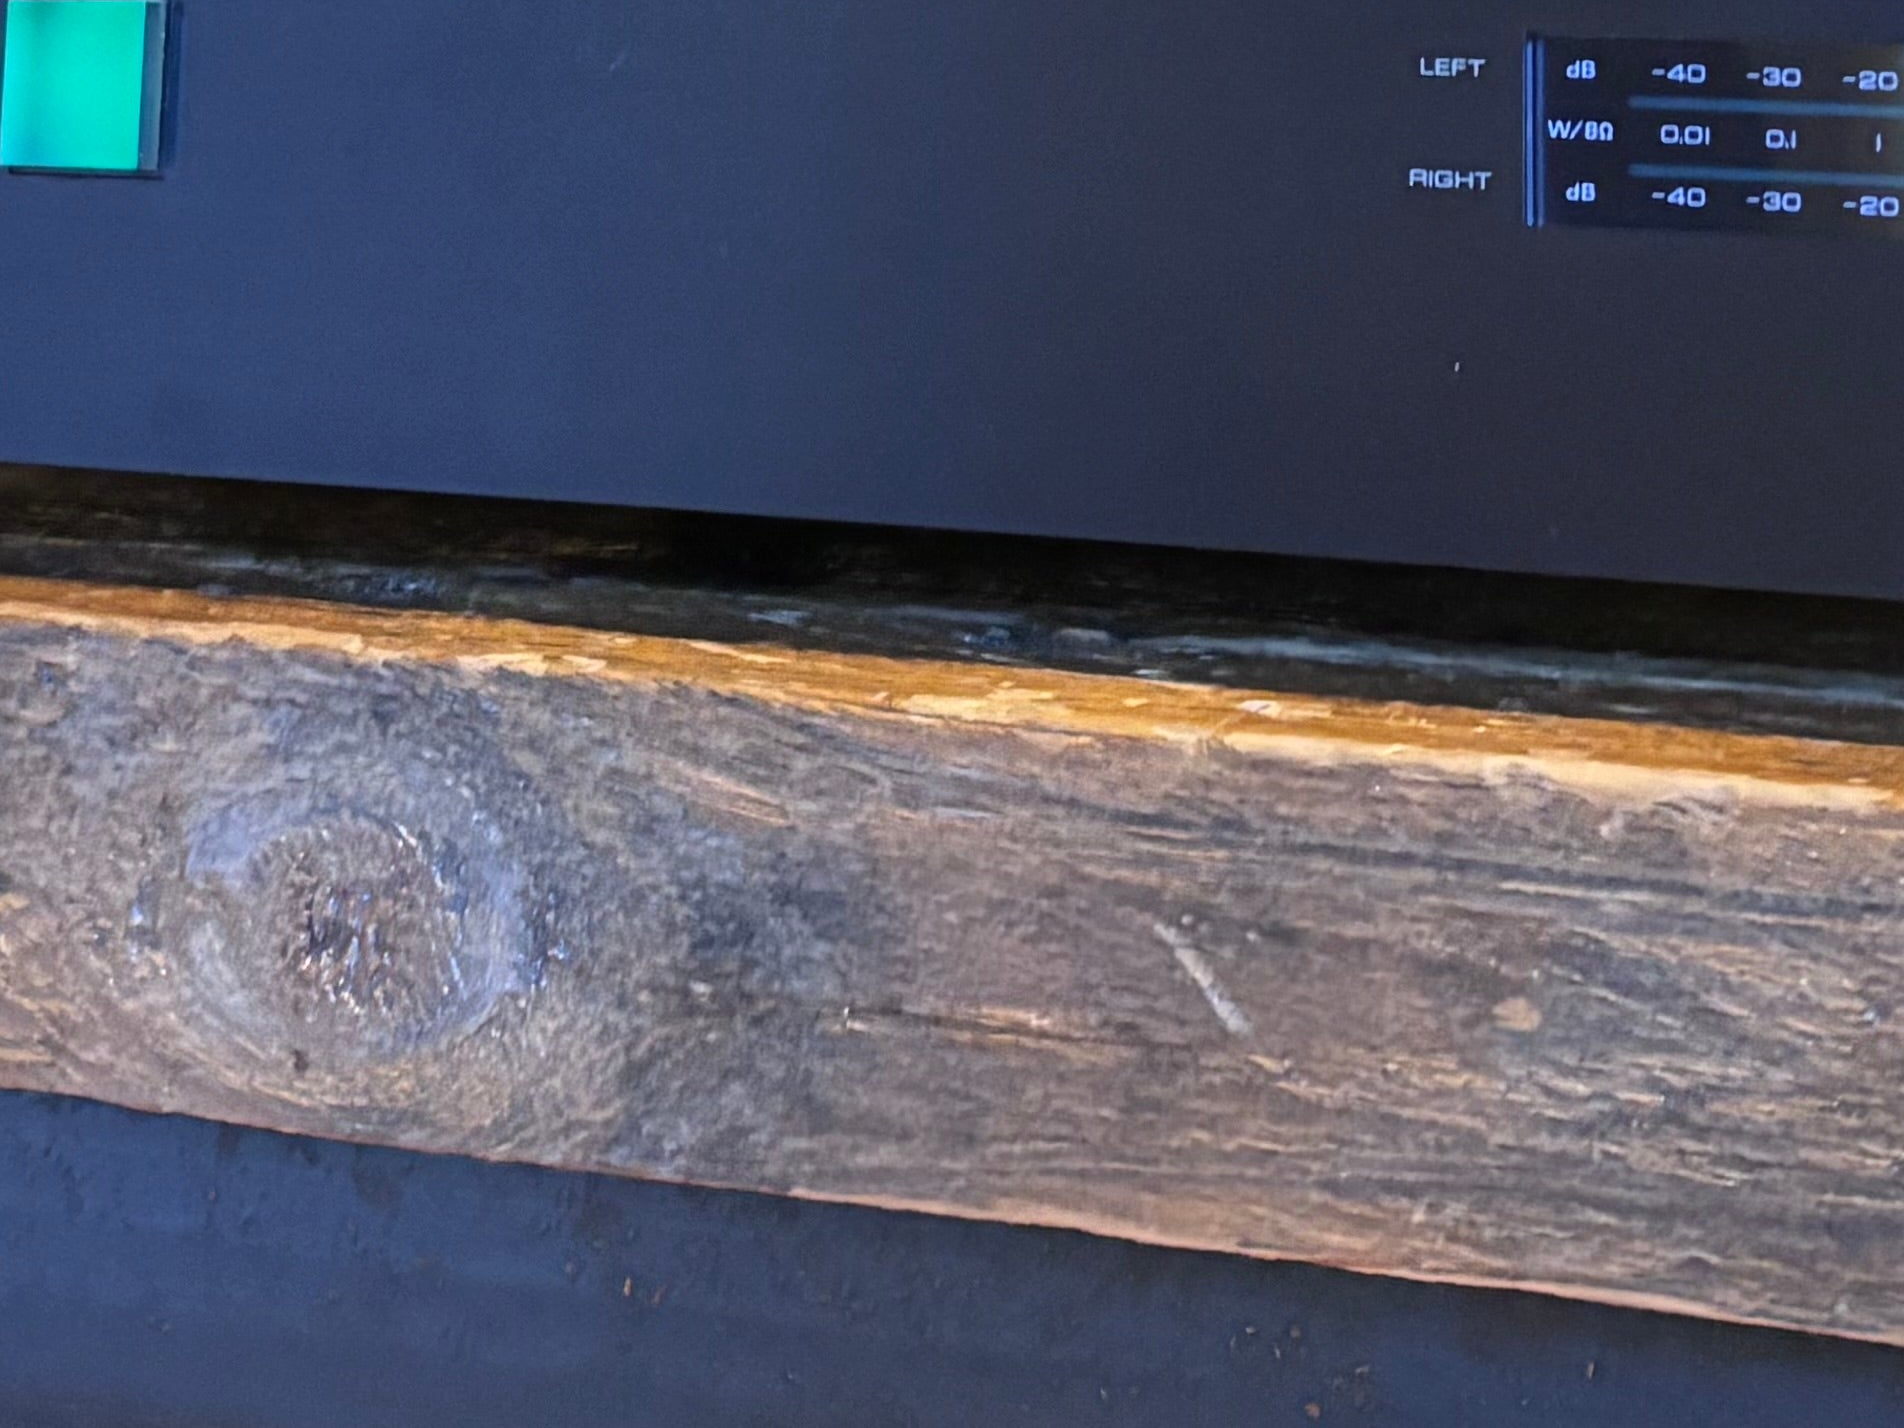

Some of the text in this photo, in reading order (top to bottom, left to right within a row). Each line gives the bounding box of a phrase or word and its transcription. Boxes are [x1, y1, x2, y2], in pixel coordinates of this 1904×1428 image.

[1420, 57, 1486, 78] LEFT
[1565, 59, 1597, 80] dB
[1652, 64, 1707, 84] -40
[1746, 67, 1802, 88] -30
[1842, 70, 1899, 92] -20
[1660, 125, 1710, 146] 0.01
[1765, 129, 1796, 150] 0.1
[1409, 168, 1492, 191] RIGHT
[1565, 182, 1596, 203] dB
[1652, 187, 1707, 208] -40
[1746, 192, 1802, 213] -30
[1843, 196, 1899, 218] -20
